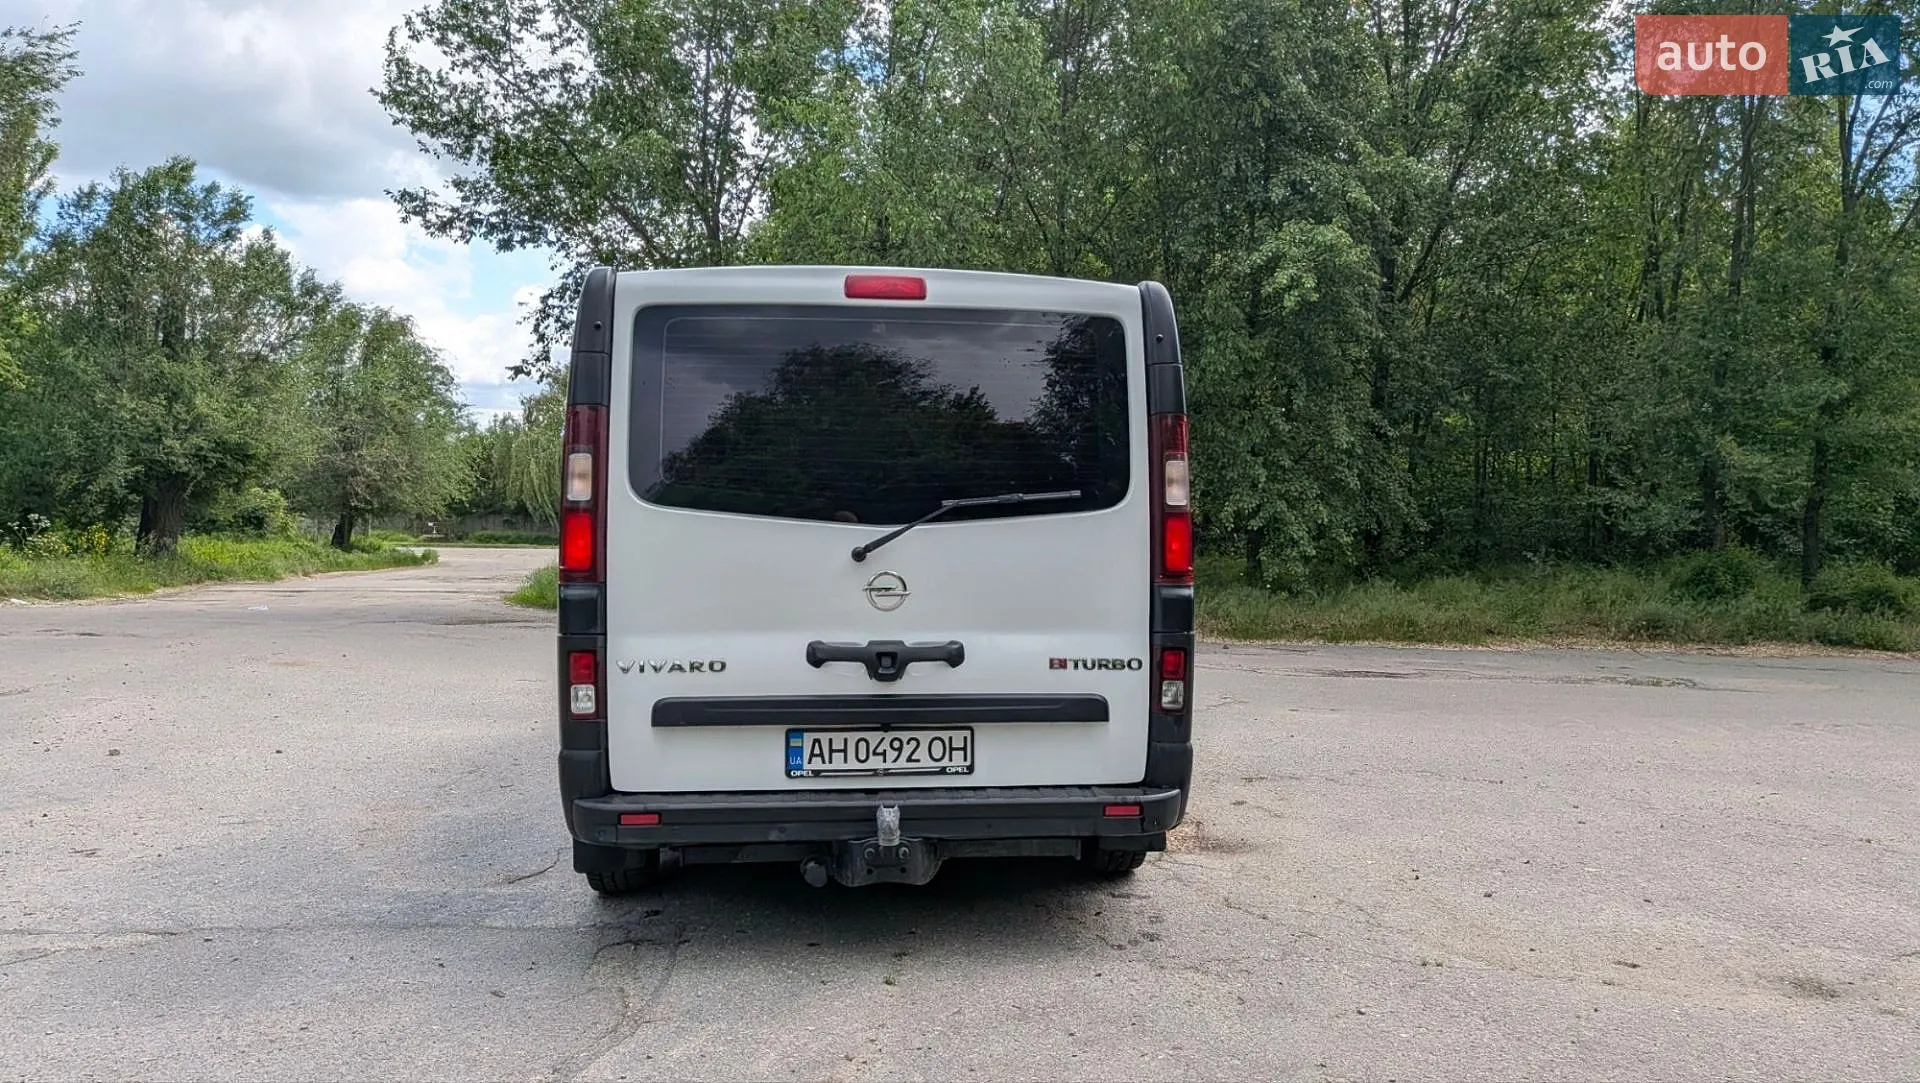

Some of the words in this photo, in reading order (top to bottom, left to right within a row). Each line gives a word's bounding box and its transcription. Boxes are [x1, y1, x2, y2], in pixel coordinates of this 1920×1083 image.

[616, 660, 727, 674] VIVARO
[1048, 658, 1143, 671] BITURBO
[807, 737, 848, 765] AH
[854, 736, 921, 764] 0492
[927, 735, 968, 763] OH
[789, 757, 803, 766] UA
[790, 769, 815, 777] OPEL
[946, 766, 970, 774] OPEL
